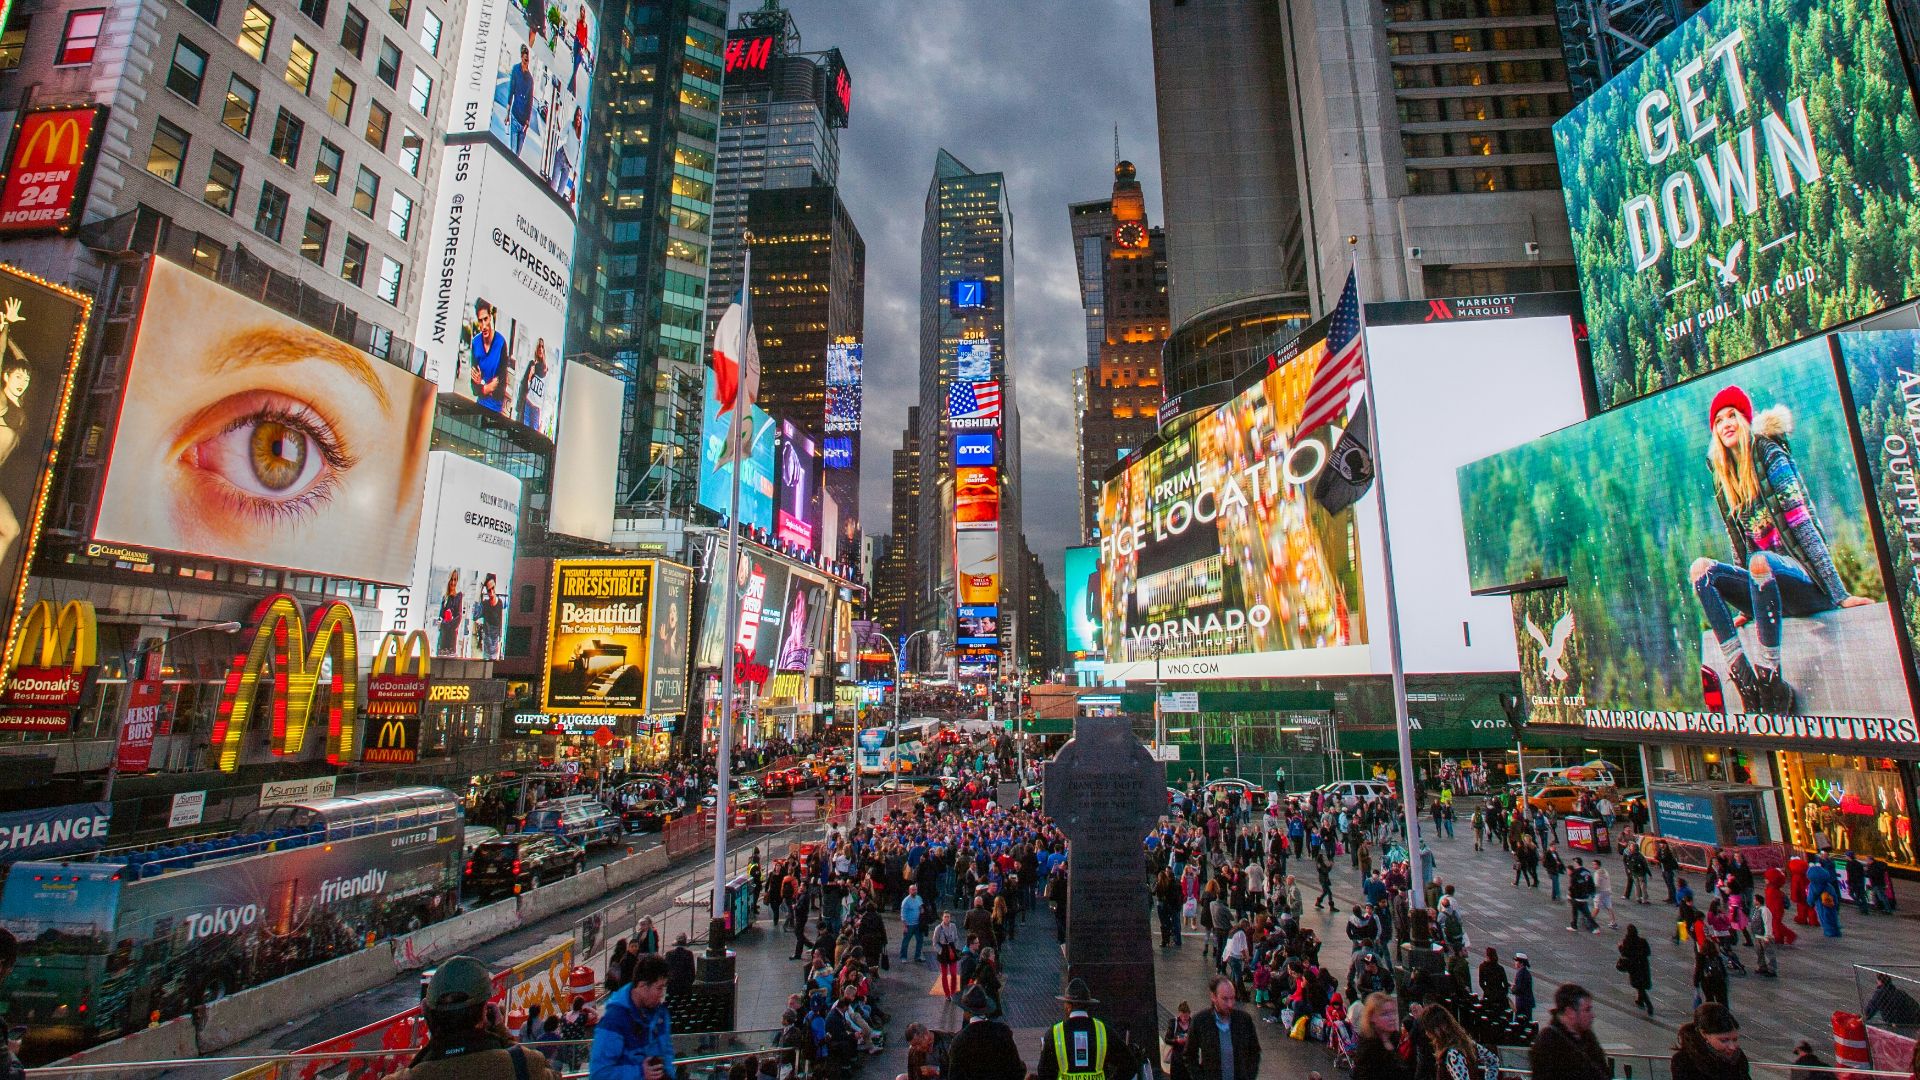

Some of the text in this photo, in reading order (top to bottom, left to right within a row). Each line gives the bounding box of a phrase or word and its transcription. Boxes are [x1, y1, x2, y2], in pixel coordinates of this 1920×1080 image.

[1635, 28, 1748, 165] GET
[19, 170, 69, 184] OPEN
[1624, 96, 1822, 273] DOWN
[17, 184, 59, 207] 24
[2, 207, 67, 223] HOURS
[516, 214, 539, 242] FOLLOW
[432, 193, 464, 344] @EXPRESSRUNWAY
[964, 284, 975, 302] 7
[1456, 296, 1516, 307] MARRIOTT
[1664, 266, 1822, 342] STAY COOL. NOT COLD.
[1458, 306, 1511, 317] MARQUIS
[963, 331, 985, 339] 2014
[1277, 337, 1300, 357] MARRIOTT
[1278, 348, 1298, 365] MARQUIS
[950, 418, 999, 428] TOSHIBA
[966, 445, 990, 454] TDK
[1155, 459, 1208, 504] PRIME
[1101, 439, 1345, 564] FICE LOCATIO
[561, 602, 643, 624] Beautiful
[959, 608, 974, 616] FOX
[561, 625, 574, 634] The
[597, 625, 614, 635] King
[614, 626, 641, 634] Musical
[1131, 604, 1271, 644] VORNADO
[1198, 634, 1246, 646] TRUST
[1167, 663, 1220, 675] VNO.COM
[5, 678, 80, 691] McDonald's
[369, 682, 425, 691] McDonald's
[771, 673, 800, 697] FOREVER
[14, 692, 65, 700] Restaurant
[429, 685, 470, 702] XPRESS
[1531, 695, 1559, 706] GREAT
[0, 715, 67, 725] OPEN 24 HOURS
[124, 704, 160, 725] JERSEY
[514, 714, 617, 726] GIFTS LUGGAGE
[128, 722, 153, 741] BOYS
[1586, 709, 1918, 743] AMERICAN EAGLE OUTFITTERS
[271, 785, 309, 798] Summit
[391, 832, 427, 847] UNITED
[319, 868, 388, 905] friendly
[185, 902, 257, 942] Tokyo
[445, 1046, 465, 1055] SONY
